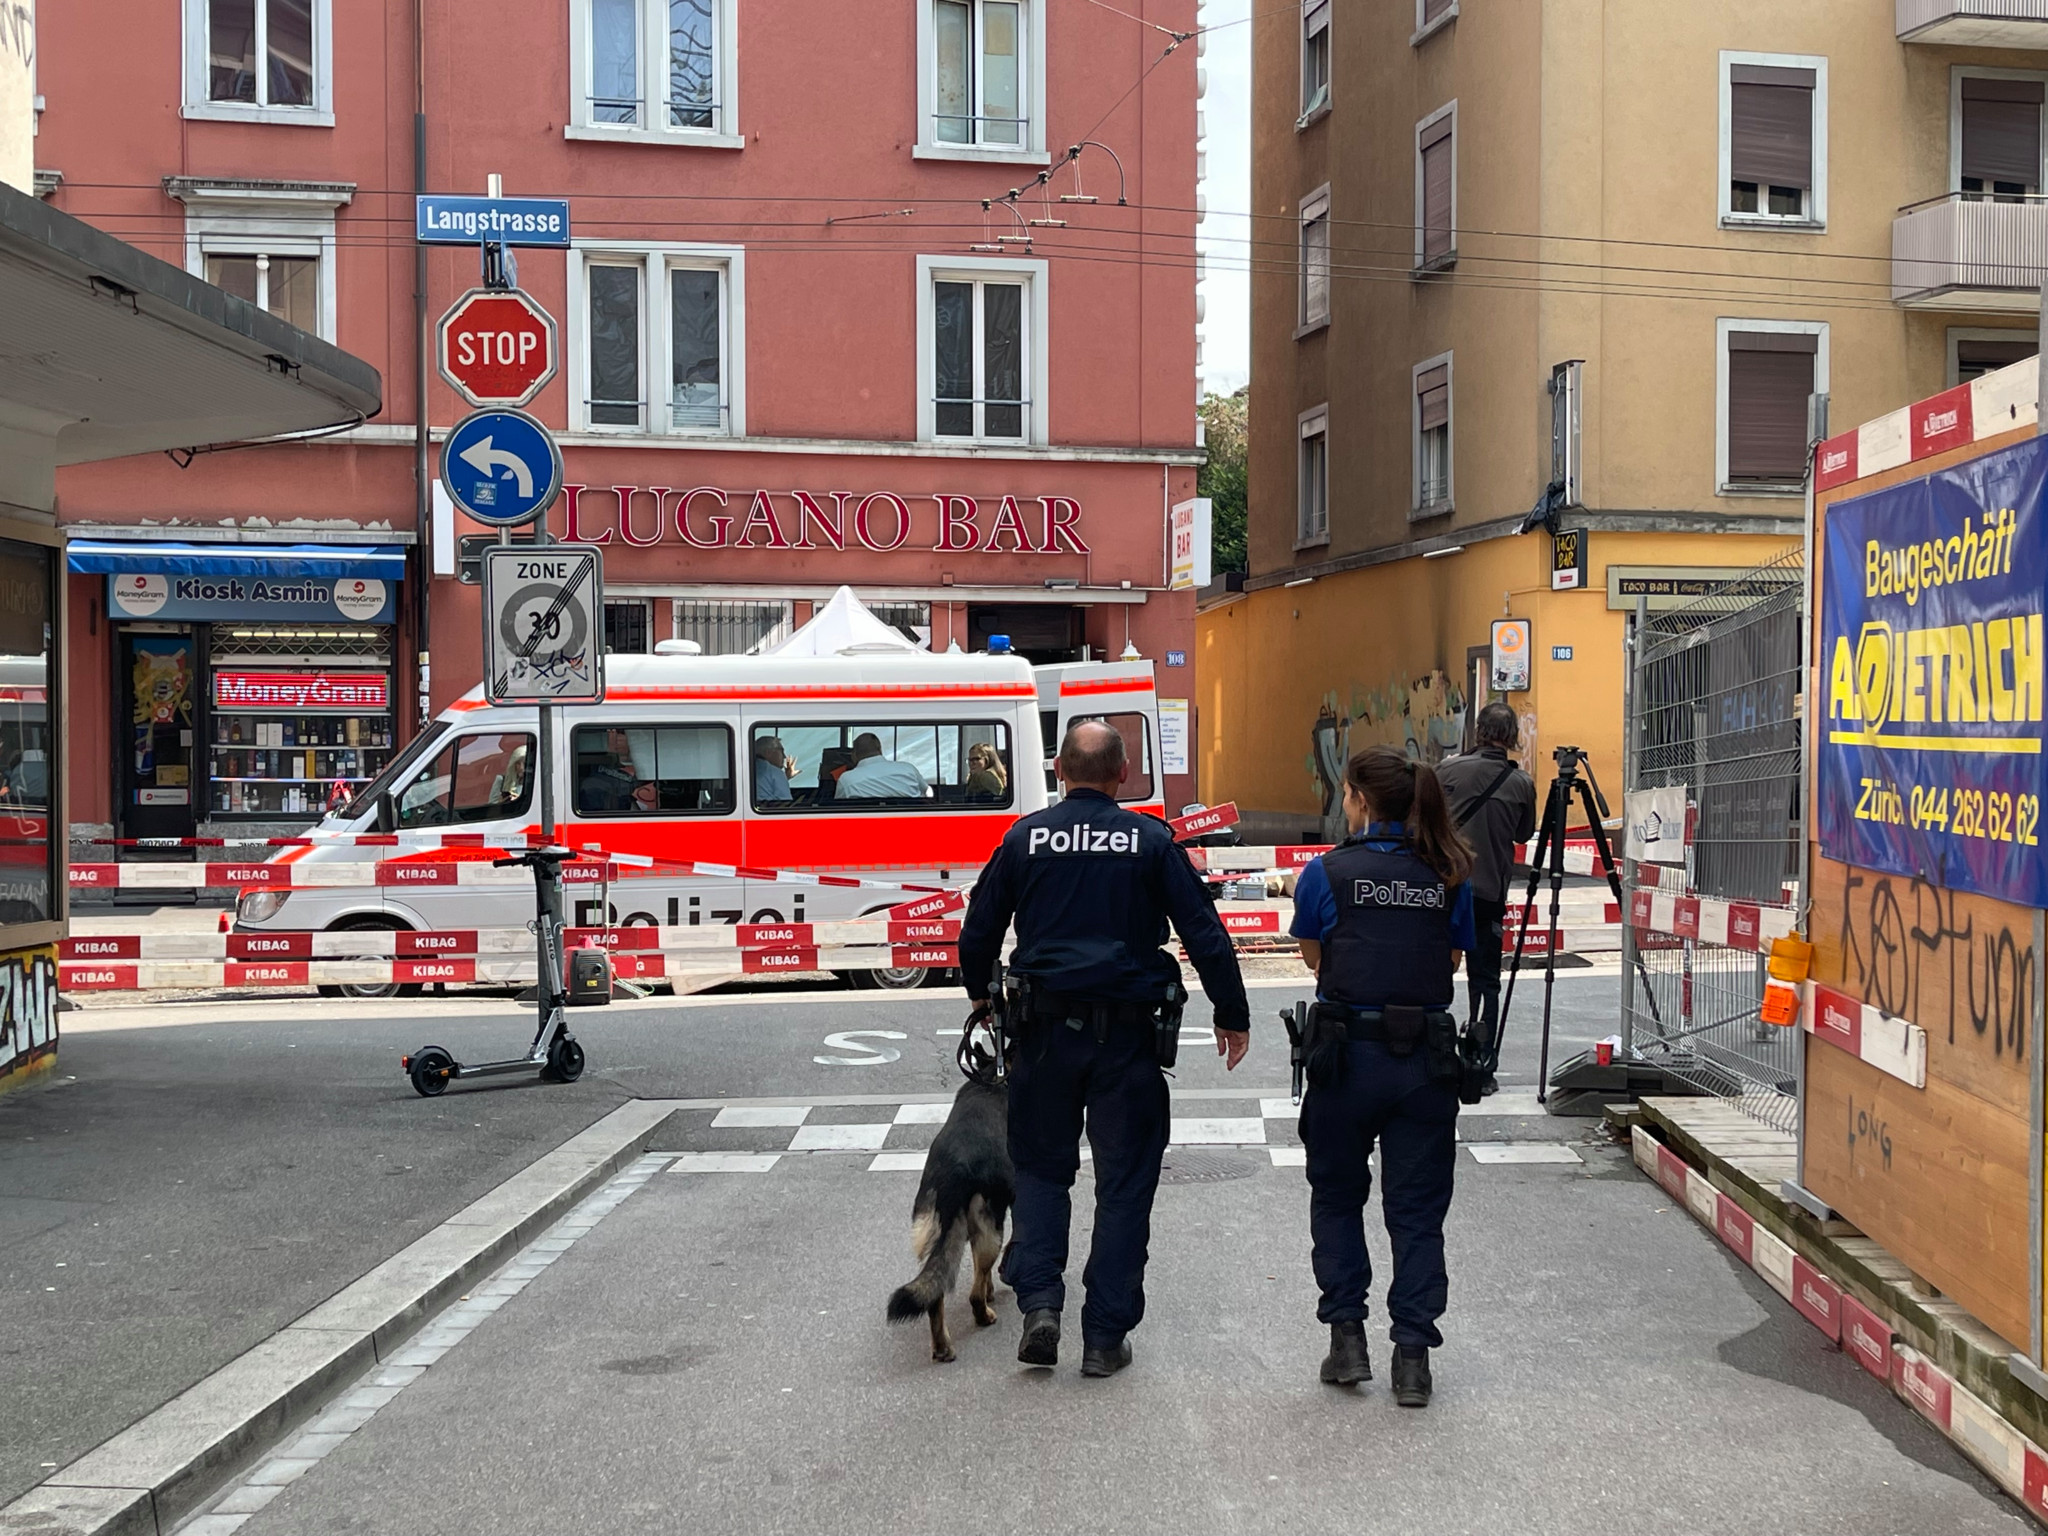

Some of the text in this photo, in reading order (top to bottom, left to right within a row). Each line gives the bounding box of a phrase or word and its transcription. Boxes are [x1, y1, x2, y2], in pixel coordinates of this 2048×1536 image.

[426, 205, 562, 237] Langstrasse
[457, 332, 537, 366] STOP
[559, 485, 1091, 555] LUGANO BAR
[1176, 532, 1191, 559] BAR
[1555, 533, 1577, 553] TACO
[1558, 550, 1574, 568] BAR
[1866, 508, 2017, 607] Baugeschäft
[516, 562, 568, 579] ZONE
[175, 578, 328, 603] Kiosk Asmin
[1622, 582, 1646, 592] TACO
[1649, 582, 1670, 592] BAR
[528, 611, 560, 640] 30
[1167, 653, 1185, 665] 108
[219, 676, 382, 706] MoneyGram
[1910, 784, 1949, 832] 044
[1951, 788, 1986, 838] 262
[1988, 790, 2013, 842] 62
[2016, 793, 2040, 846] 62
[1185, 813, 1222, 832] KIBAG
[1028, 822, 1140, 856] Polizei
[1292, 851, 1327, 862] KIB
[69, 870, 97, 882] BAG
[226, 869, 270, 881] KIBAG
[396, 869, 438, 880] KIBAG
[1354, 880, 1446, 909] Polizei
[908, 900, 946, 918] KIBAG
[1226, 917, 1262, 927] KIBAG
[756, 929, 794, 940] KIBAG
[906, 925, 944, 937] KIBAG
[74, 942, 119, 953] KIBAG
[247, 940, 290, 951] KIBAG
[415, 937, 457, 948] KIBAG
[761, 955, 800, 966] KIBAG
[910, 951, 948, 962] KIBAG
[245, 968, 289, 981] KIBAG
[413, 964, 455, 977] KIBAG
[71, 971, 116, 984] KIBAG
